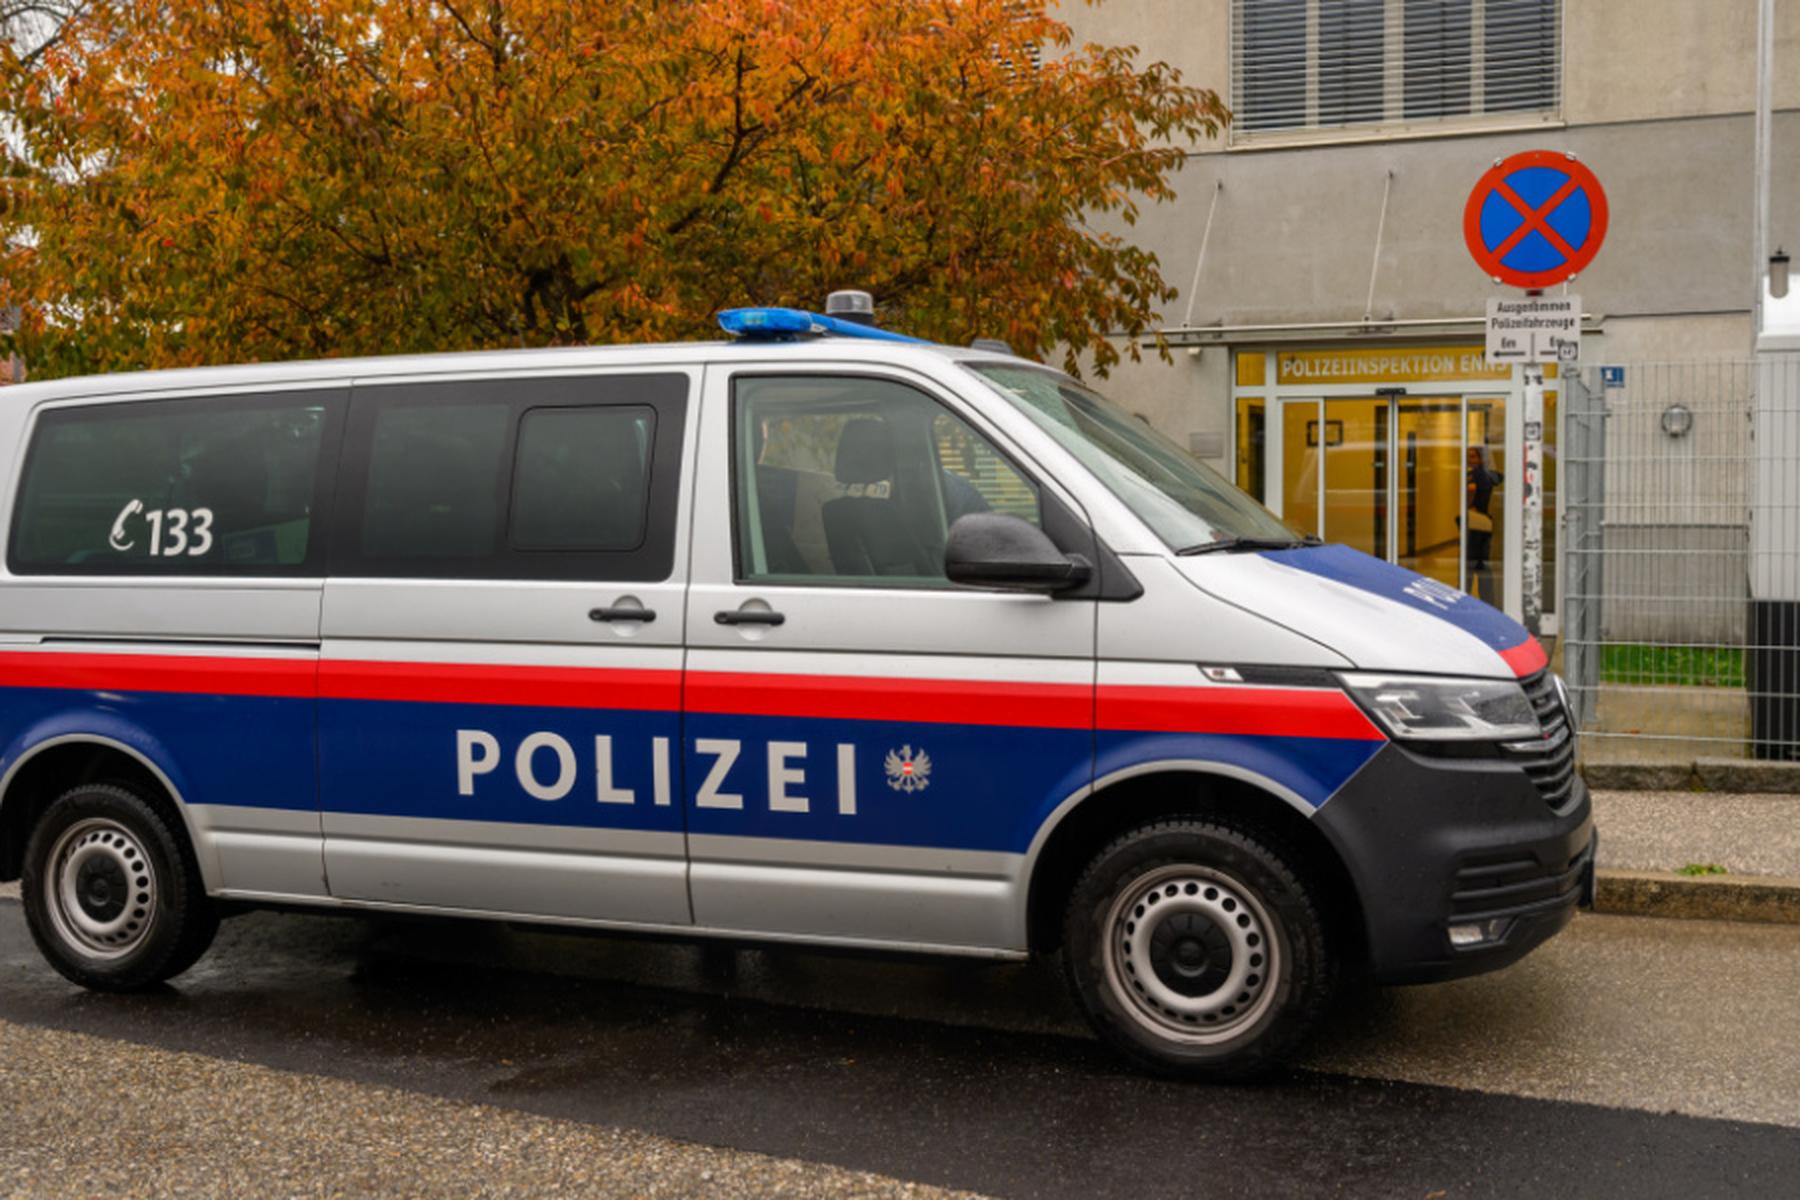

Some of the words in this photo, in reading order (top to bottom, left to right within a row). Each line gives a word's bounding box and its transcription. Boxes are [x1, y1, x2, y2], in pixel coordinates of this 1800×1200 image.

[1491, 317, 1575, 330] Polizeifahrzeuge
[1282, 355, 1455, 377] POLIZEIINSPEKTION
[145, 507, 214, 557] 133
[456, 729, 857, 815] POLIZEI
